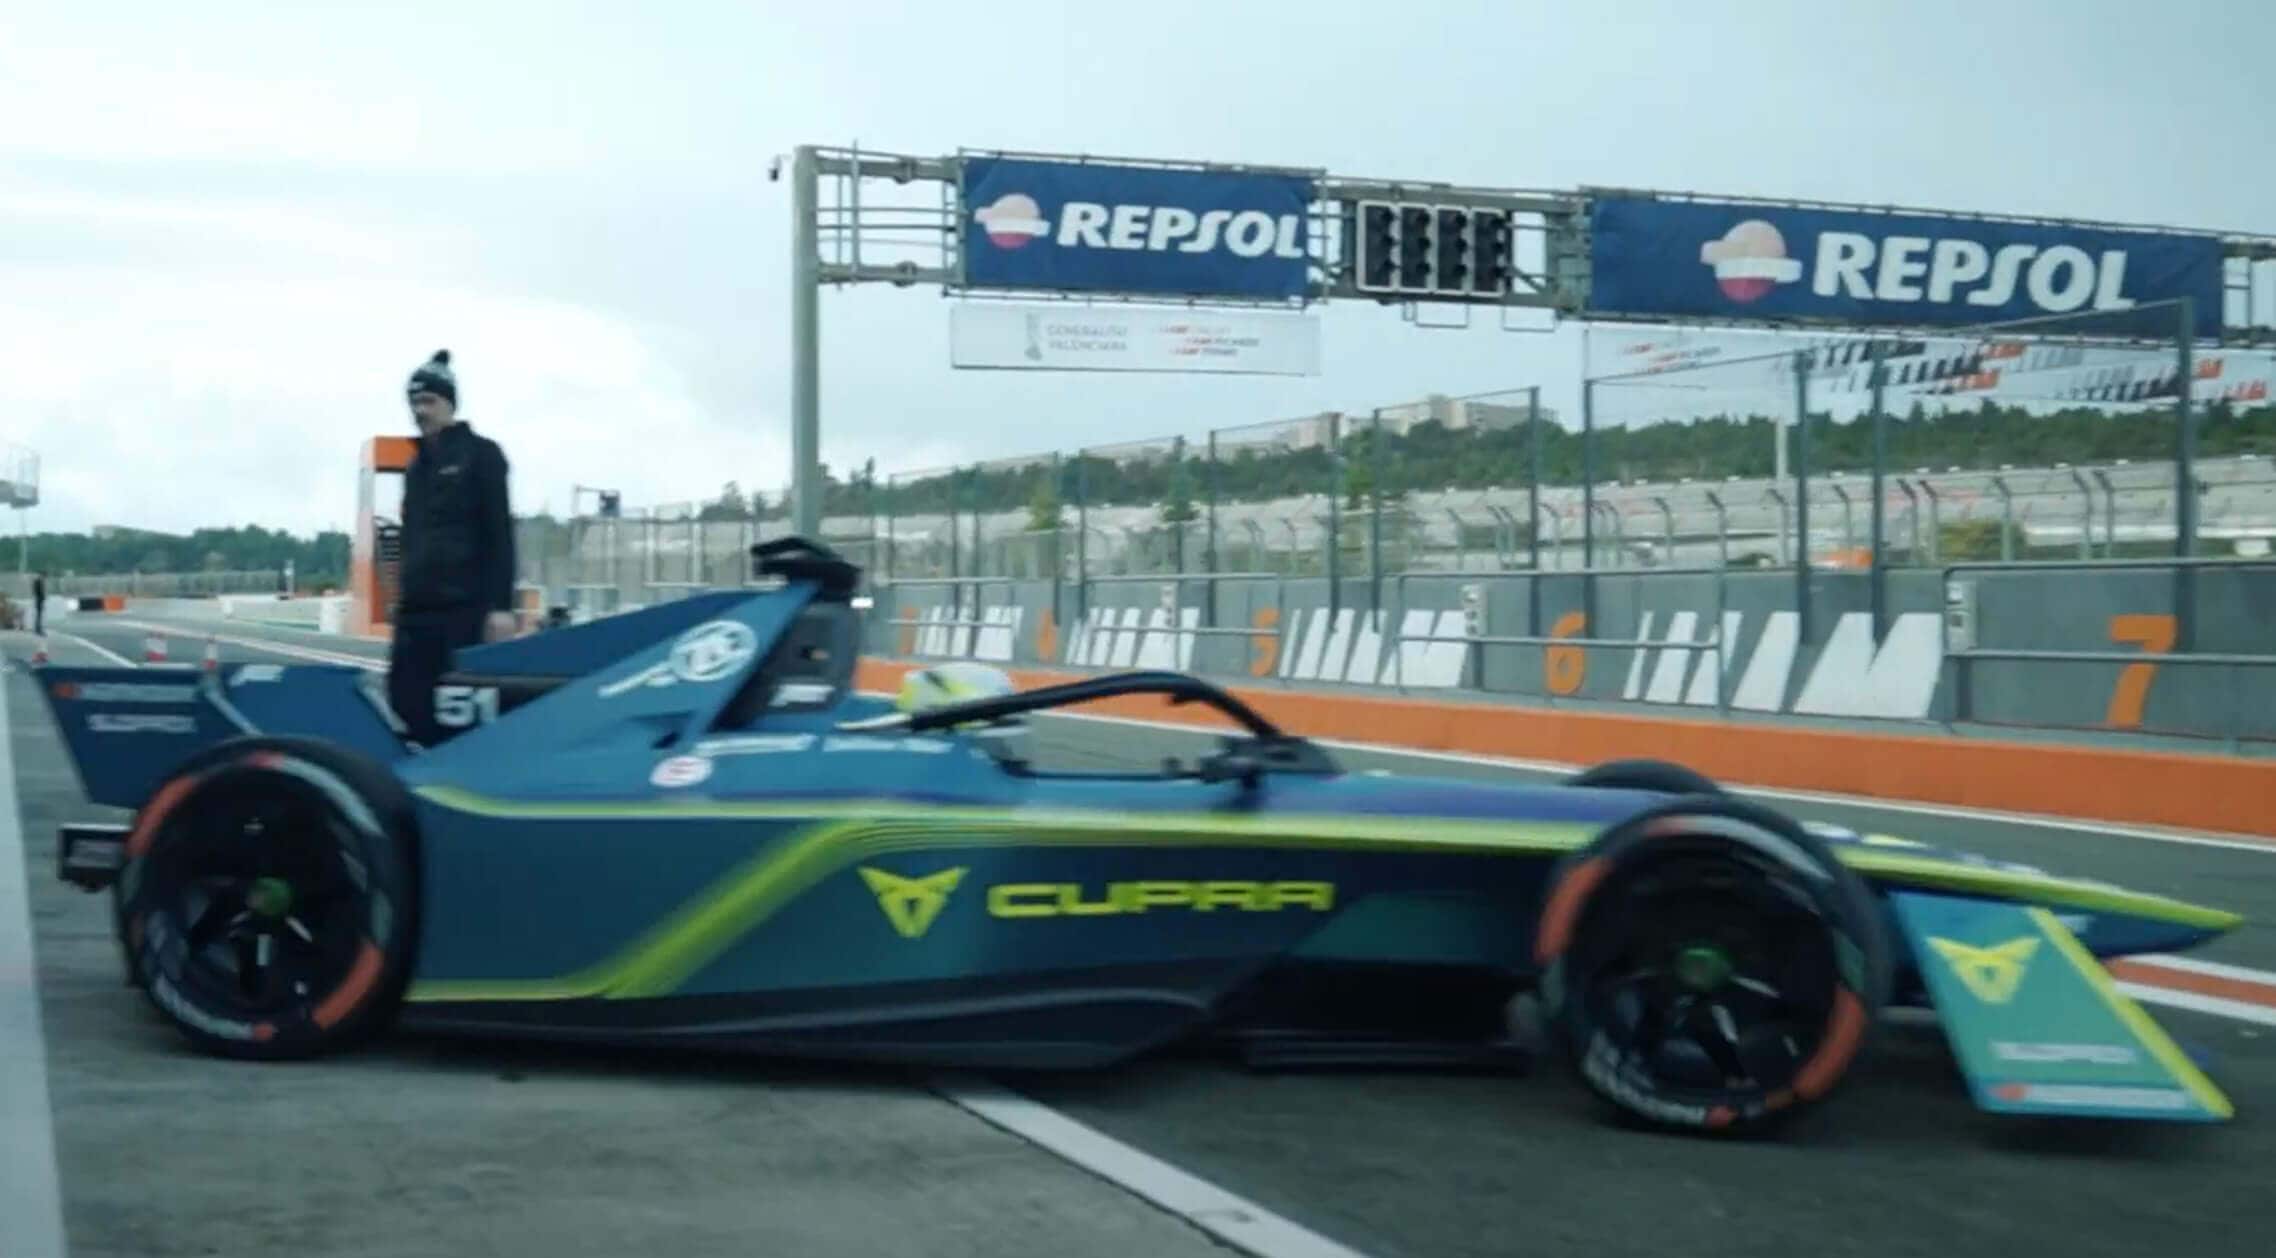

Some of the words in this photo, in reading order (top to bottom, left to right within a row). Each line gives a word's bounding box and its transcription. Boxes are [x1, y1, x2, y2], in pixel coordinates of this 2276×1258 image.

[1057, 202, 1304, 258] REPSOL
[1812, 231, 2136, 312] REPSOL
[1546, 612, 1586, 696] 6
[2106, 614, 2177, 728] 7
[433, 685, 499, 727] 51
[988, 881, 1334, 918] CUPRA
